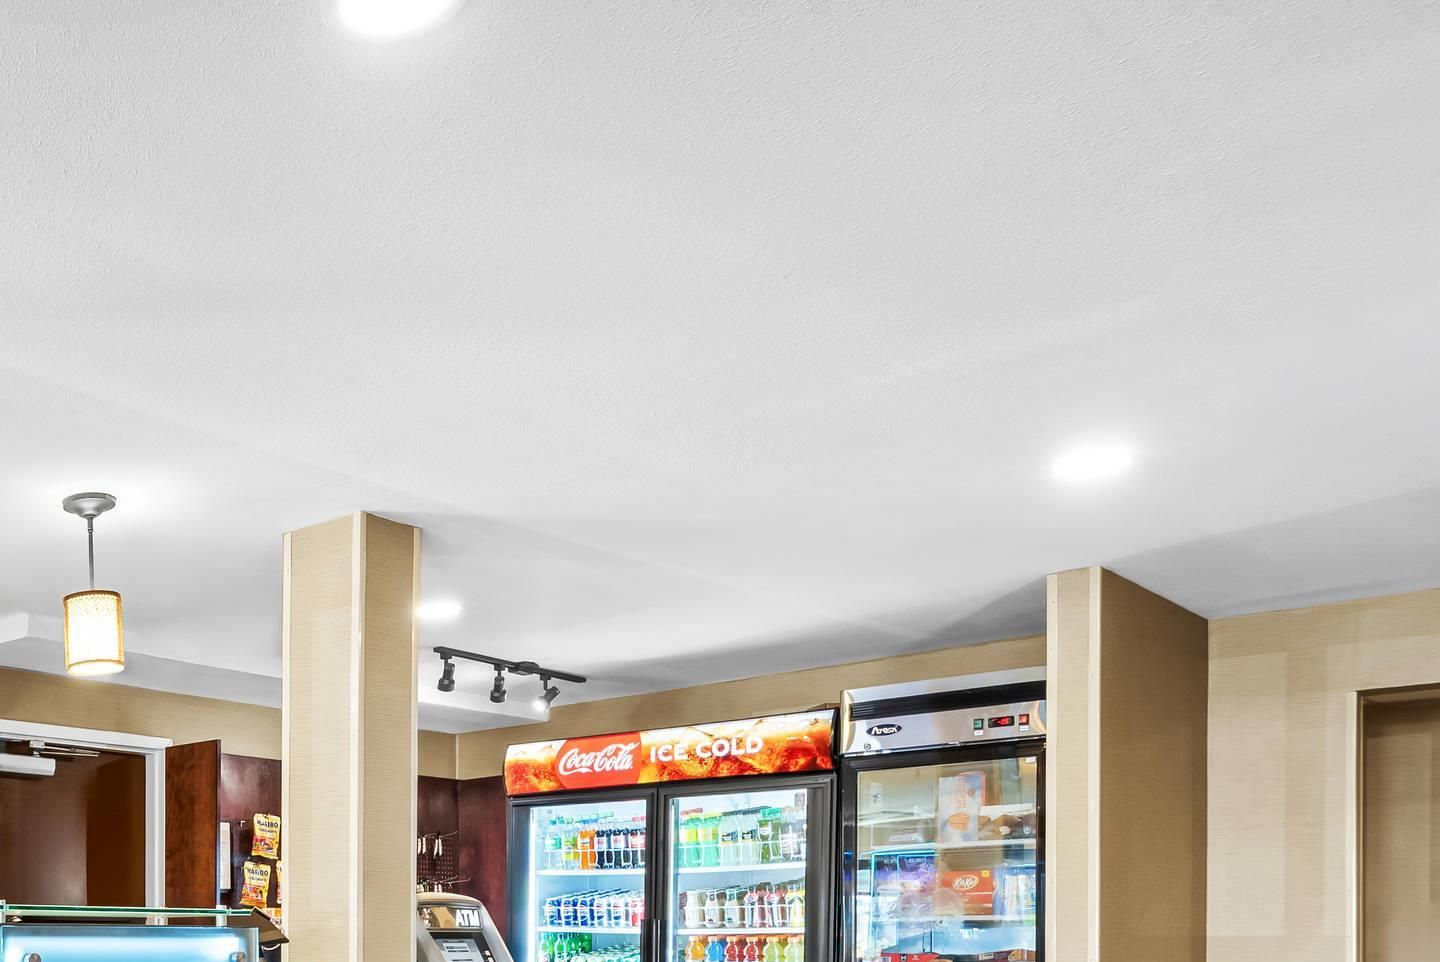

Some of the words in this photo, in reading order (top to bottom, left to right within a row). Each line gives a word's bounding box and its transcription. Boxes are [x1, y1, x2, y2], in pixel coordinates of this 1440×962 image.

[558, 741, 640, 776] Coca-Cola
[650, 745, 688, 763] ICE
[696, 736, 764, 759] COLD
[455, 909, 480, 927] ATM
